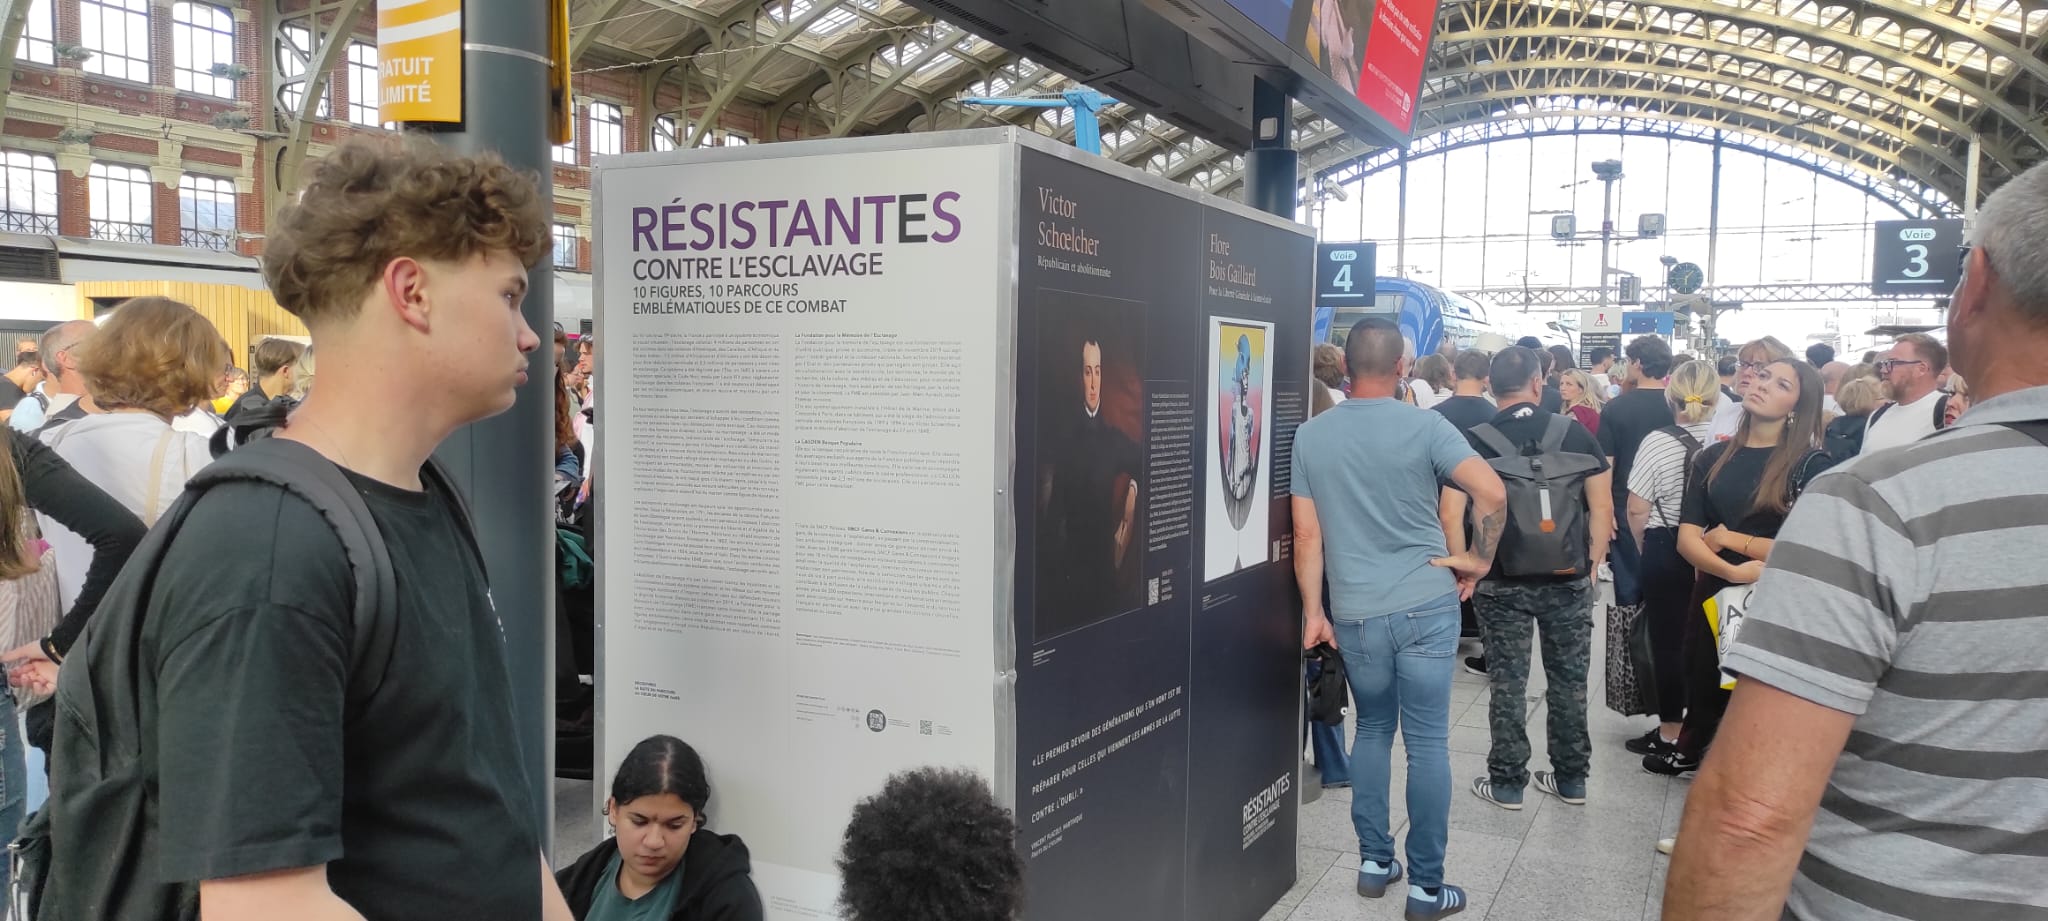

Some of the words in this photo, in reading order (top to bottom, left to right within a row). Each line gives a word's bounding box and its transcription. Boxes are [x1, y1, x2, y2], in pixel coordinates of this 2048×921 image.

[1039, 186, 1077, 219] Victor
[632, 191, 961, 252] RÉSISTANTES
[1904, 229, 1931, 239] Voie
[1039, 221, 1099, 256] Schœlcher
[1210, 233, 1229, 256] Flore
[633, 257, 723, 280] CONTRE
[730, 252, 883, 278] L'ESCLAVAGE
[1037, 255, 1070, 270] Républicain
[1071, 263, 1076, 272] et
[1210, 260, 1226, 281] Bois
[1227, 264, 1256, 286] Gaillard
[1902, 244, 1929, 278] 3
[633, 286, 647, 298] 10
[650, 285, 705, 299] FIGURES,
[709, 284, 723, 297] 10
[727, 283, 798, 297] PARCOURS
[1333, 264, 1353, 292] 4
[633, 299, 741, 314] EMBLÉMATIQUES
[744, 300, 762, 313] DE
[766, 300, 783, 313] CE
[786, 299, 847, 313] COMBAT
[1045, 741, 1070, 761] PREMIER
[1070, 731, 1091, 748] DEVOIR
[1091, 725, 1101, 738] DES
[1102, 708, 1135, 732] GÉNÉRATIONS
[1135, 705, 1144, 717] QUI
[1155, 693, 1167, 706] VONT
[1167, 688, 1176, 700] EST
[1032, 773, 1060, 796] PRÉPARER
[1061, 764, 1076, 780] POUR
[1077, 753, 1097, 770] CELLES
[1097, 748, 1107, 763] QUI
[1107, 735, 1131, 754] VIENNENT
[1131, 729, 1140, 741] LES
[1140, 721, 1156, 736] ARMES
[1156, 719, 1162, 729] DE
[1162, 715, 1168, 725] LA
[1168, 708, 1181, 721] LUTTE
[1243, 771, 1290, 825] RÉSISTANTES
[1031, 802, 1054, 824] CONTRE
